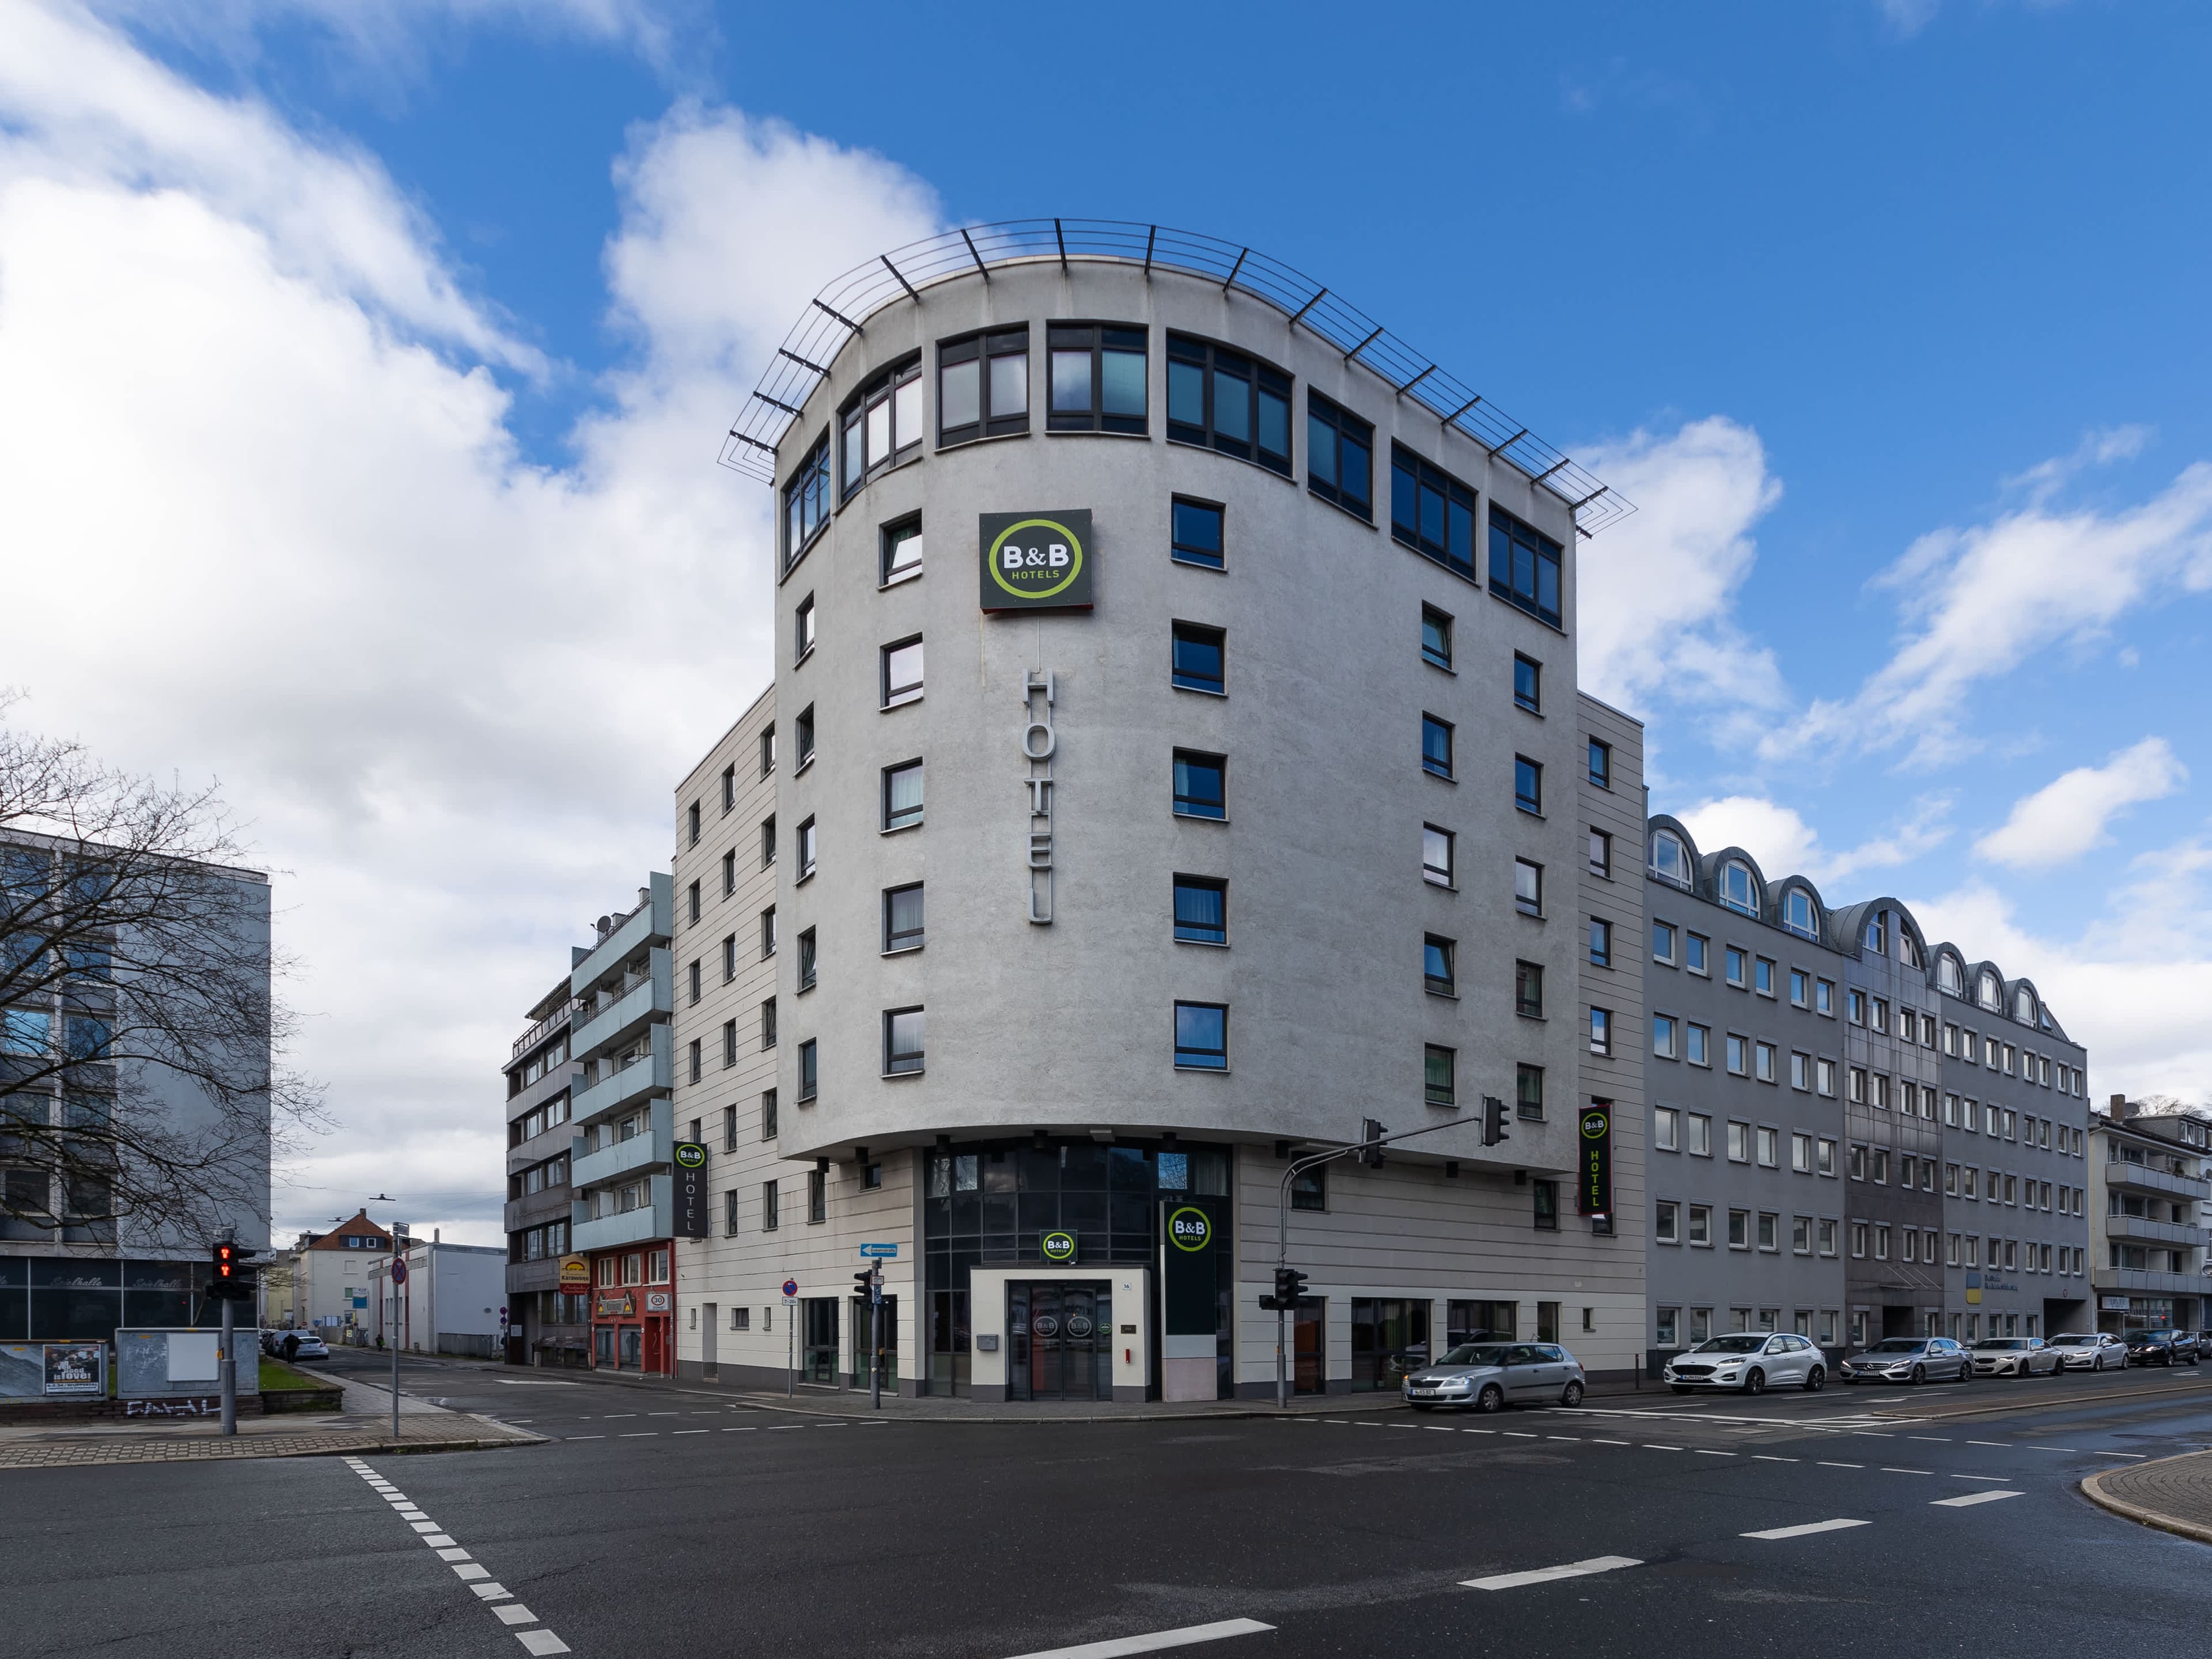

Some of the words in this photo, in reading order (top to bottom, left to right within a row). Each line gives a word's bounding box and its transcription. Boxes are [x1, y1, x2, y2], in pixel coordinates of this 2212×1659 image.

[1003, 544, 1069, 569] B&B
[1012, 570, 1059, 579] HOTELS
[1021, 667, 1056, 925] HOTEL
[1585, 1120, 1604, 1130] B&B
[680, 1150, 701, 1159] B&B
[1590, 1150, 1599, 1206] HOTEL
[686, 1172, 695, 1230] HOTEL
[1175, 1221, 1205, 1234] B&B
[1047, 1241, 1070, 1249] B&B
[50, 1277, 103, 1286] Spielhalle
[133, 1278, 183, 1288] Spielhalle
